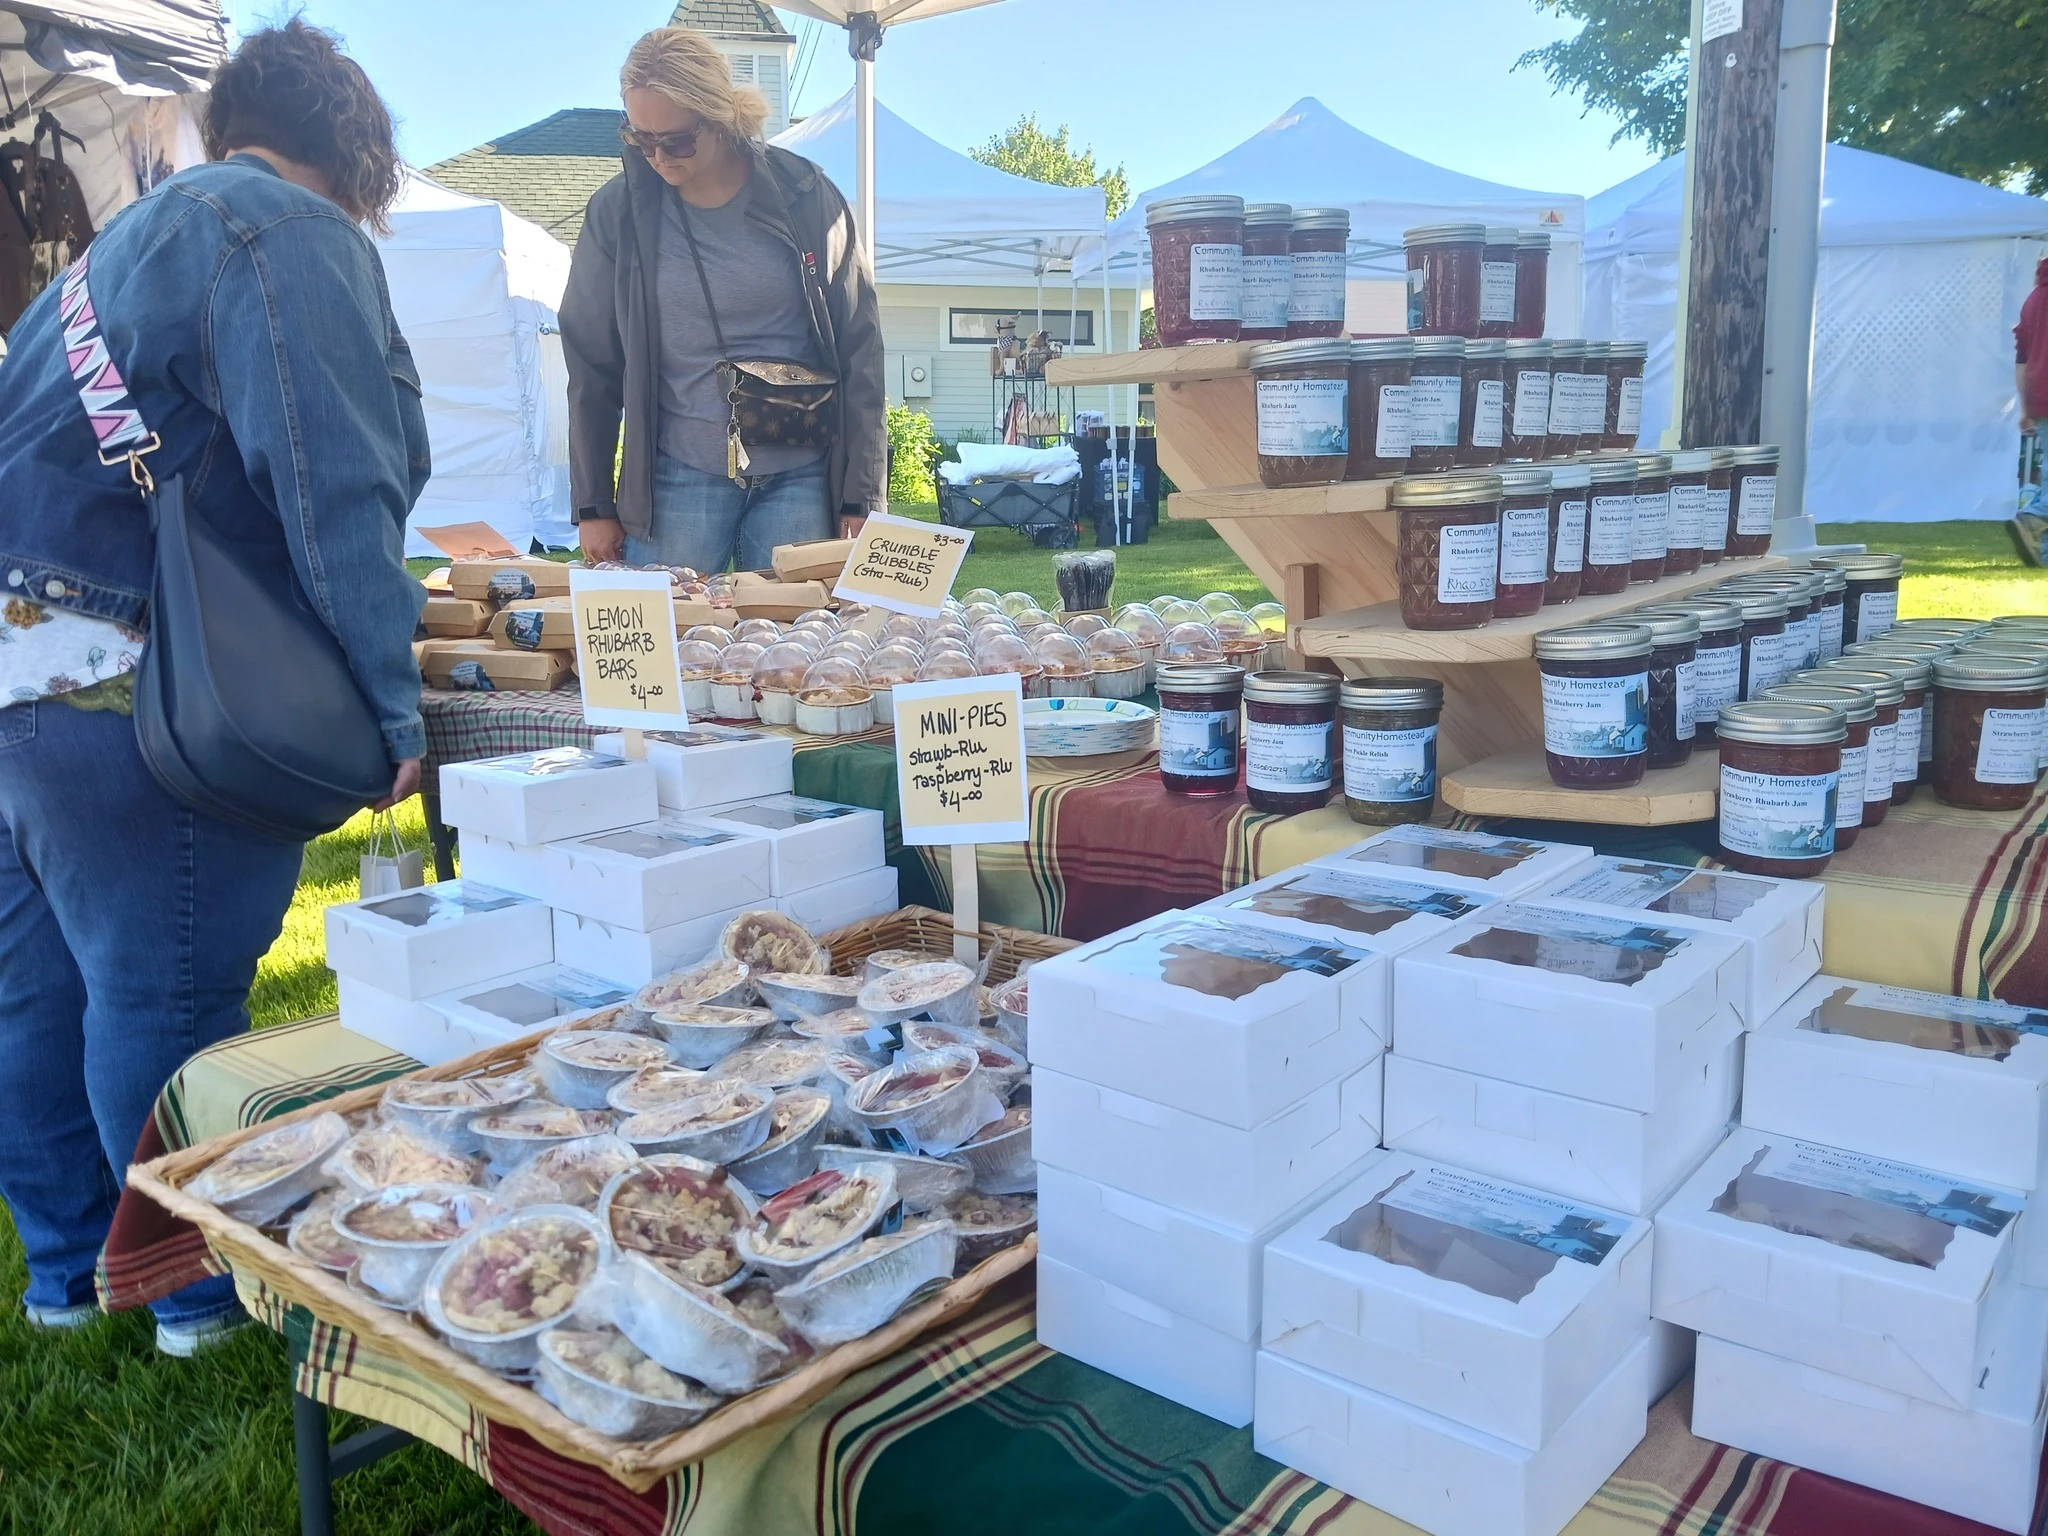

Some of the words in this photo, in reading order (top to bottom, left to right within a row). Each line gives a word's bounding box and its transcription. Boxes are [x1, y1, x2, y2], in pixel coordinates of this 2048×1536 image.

[1258, 382, 1299, 393] Community
[1446, 527, 1492, 537] Community
[869, 537, 940, 561] CRUMBLE
[868, 552, 935, 575] BUBBLES
[586, 603, 644, 632] LEMON
[587, 633, 656, 657] RHUBARB
[1696, 650, 1733, 660] ommunity
[596, 659, 638, 681] BARS
[1570, 679, 1626, 690] Homestead
[1554, 698, 1584, 710] Blueberry
[920, 702, 1007, 739] MINI-PIES
[1170, 711, 1209, 720] Homestead
[1989, 710, 2038, 721] Community
[1992, 730, 2029, 738] Strawberry
[1353, 748, 1368, 757] Pickle
[936, 762, 945, 772] +
[1769, 776, 1827, 788] Homestead
[1755, 797, 1790, 807] Rhubarb
[1795, 1143, 1872, 1165] Community
[1878, 1161, 1959, 1186] Homestead
[1426, 1180, 1444, 1188] Two
[1469, 1191, 1482, 1199] Pie
[1430, 1167, 1496, 1190] Community
[1501, 1187, 1575, 1212] Homestead
